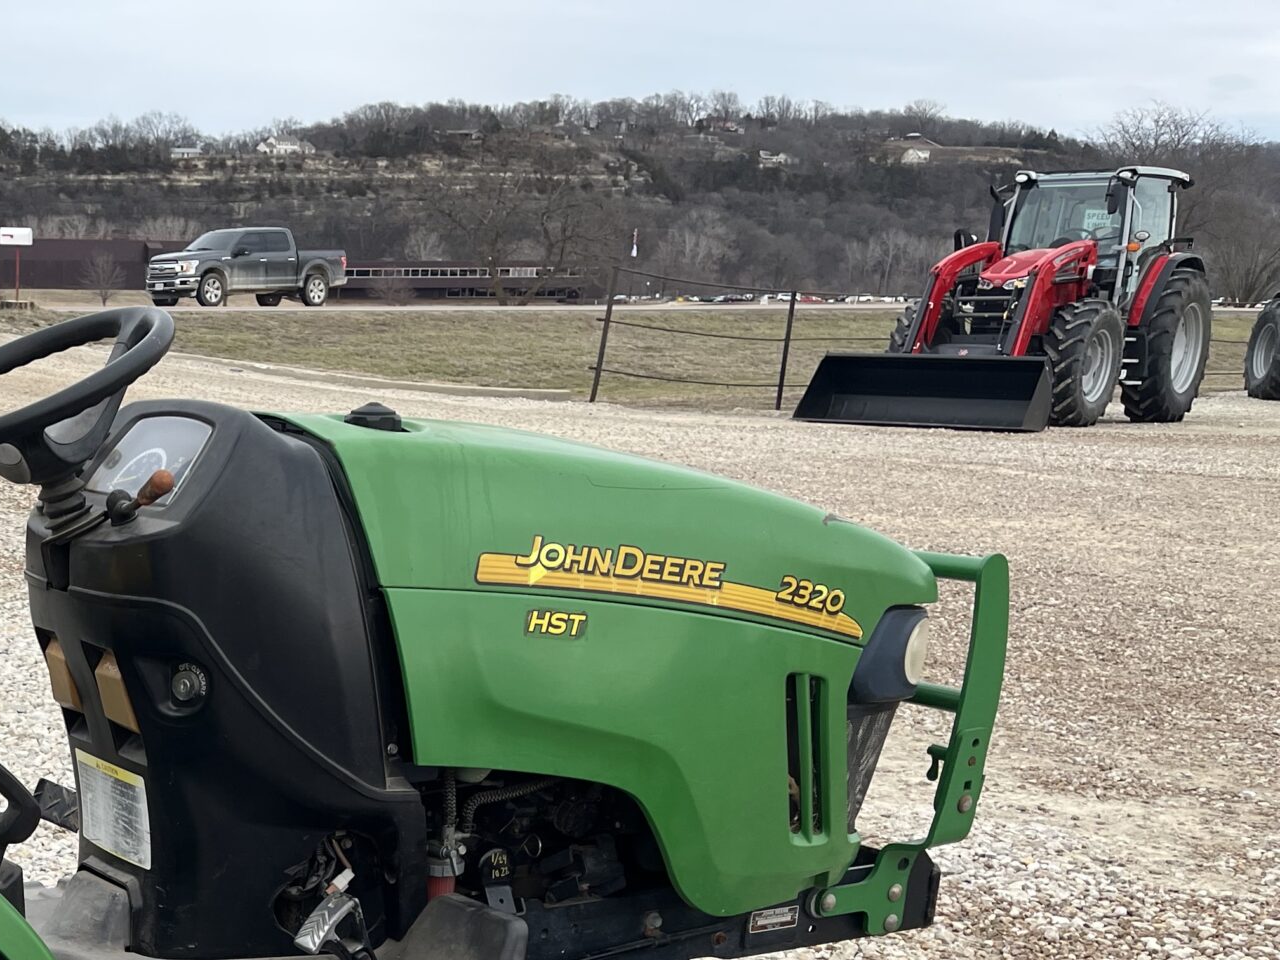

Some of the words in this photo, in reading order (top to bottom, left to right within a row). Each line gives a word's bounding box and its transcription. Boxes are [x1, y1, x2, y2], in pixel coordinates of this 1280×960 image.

[515, 534, 614, 576] JOHN
[614, 544, 725, 588] DEERE
[775, 575, 845, 615] 2320
[527, 610, 587, 638] HST
